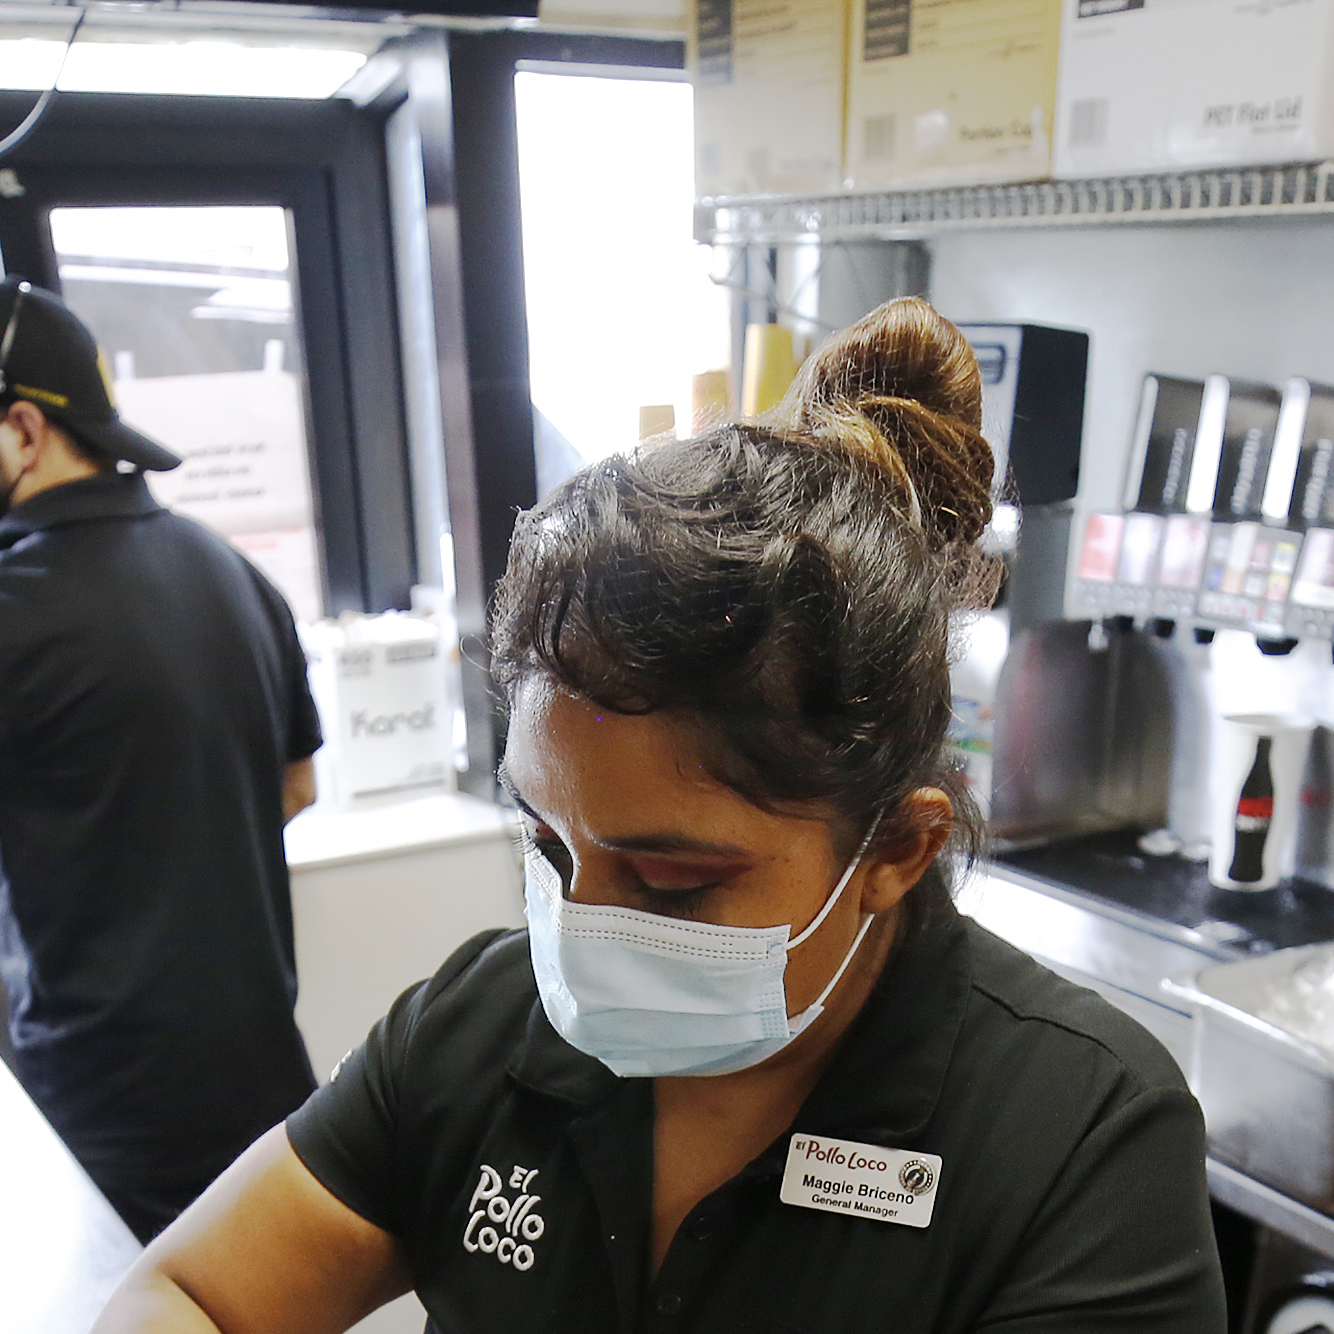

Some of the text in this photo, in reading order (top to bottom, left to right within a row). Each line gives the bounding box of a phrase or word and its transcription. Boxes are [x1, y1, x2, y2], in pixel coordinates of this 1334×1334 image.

[805, 1140, 846, 1165] Pollo
[847, 1151, 888, 1172] Loco
[508, 1164, 539, 1191] El
[802, 1173, 915, 1206] Maggie Briceno
[468, 1164, 545, 1241] Pollo
[811, 1193, 900, 1218] General Manager
[463, 1209, 536, 1272] Loco
